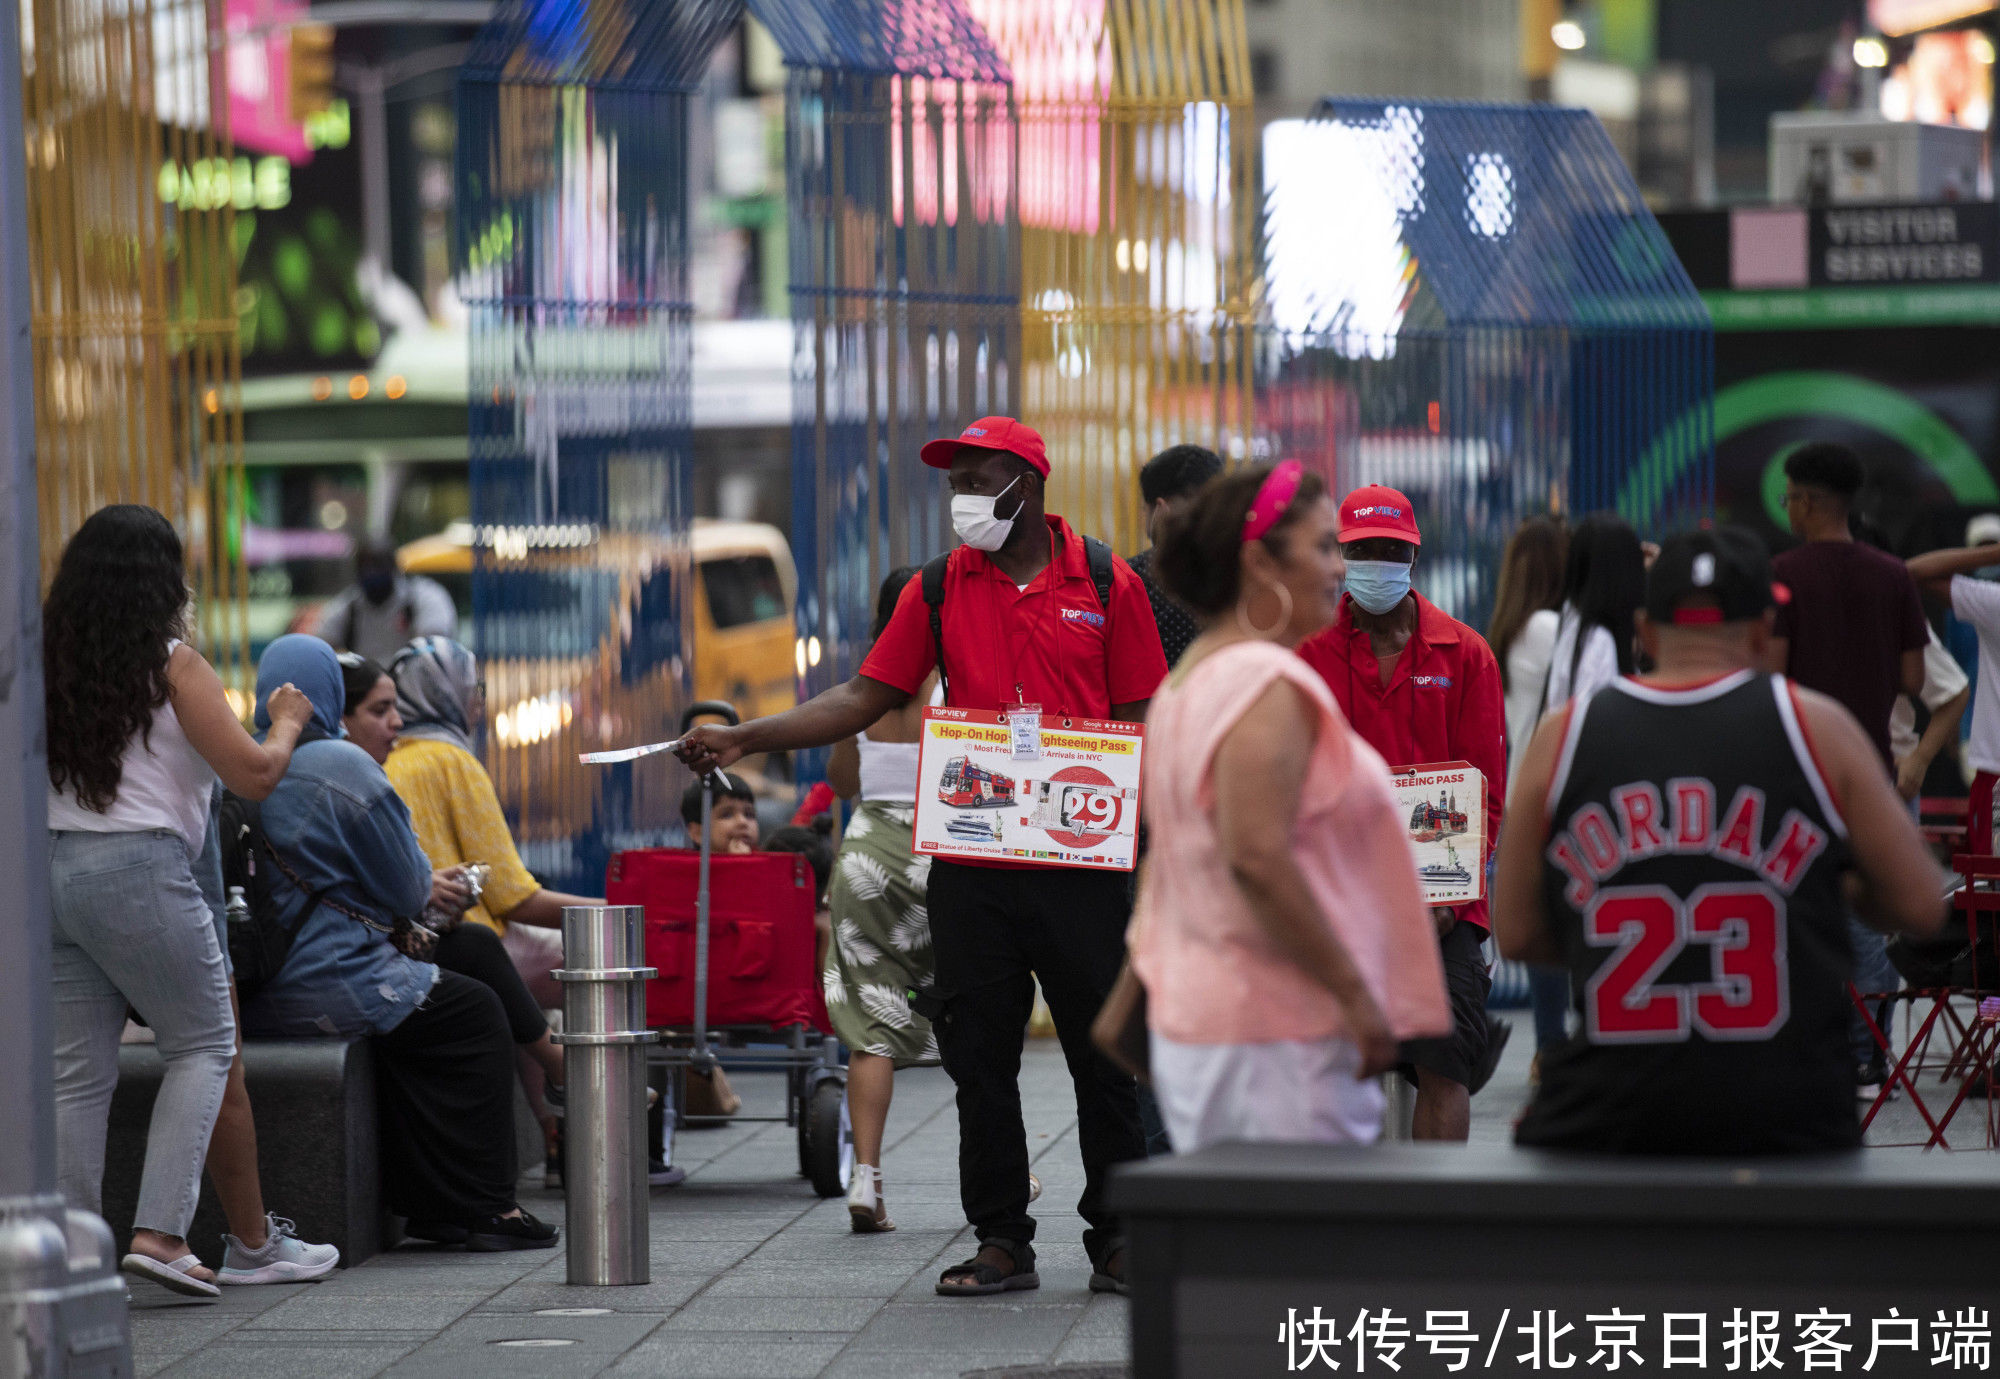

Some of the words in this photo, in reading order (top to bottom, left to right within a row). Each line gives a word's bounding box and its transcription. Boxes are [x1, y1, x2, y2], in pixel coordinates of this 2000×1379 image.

[1826, 207, 1957, 244] VISITOR
[1826, 244, 1983, 280] SERVICES
[1353, 506, 1401, 519] TOPVIEW
[1061, 608, 1105, 624] TOPVIEW
[931, 708, 968, 718] TOPVIEW
[940, 726, 982, 740] Hop-On
[1040, 734, 1097, 751] ightseeing
[1100, 739, 1127, 752] Pass
[974, 744, 993, 753] Most
[1047, 751, 1075, 760] Arrivals
[1086, 754, 1103, 762] NYC
[1436, 773, 1465, 785] PASS
[1547, 777, 1828, 911] JORDAN
[1584, 881, 1790, 1044] 23
